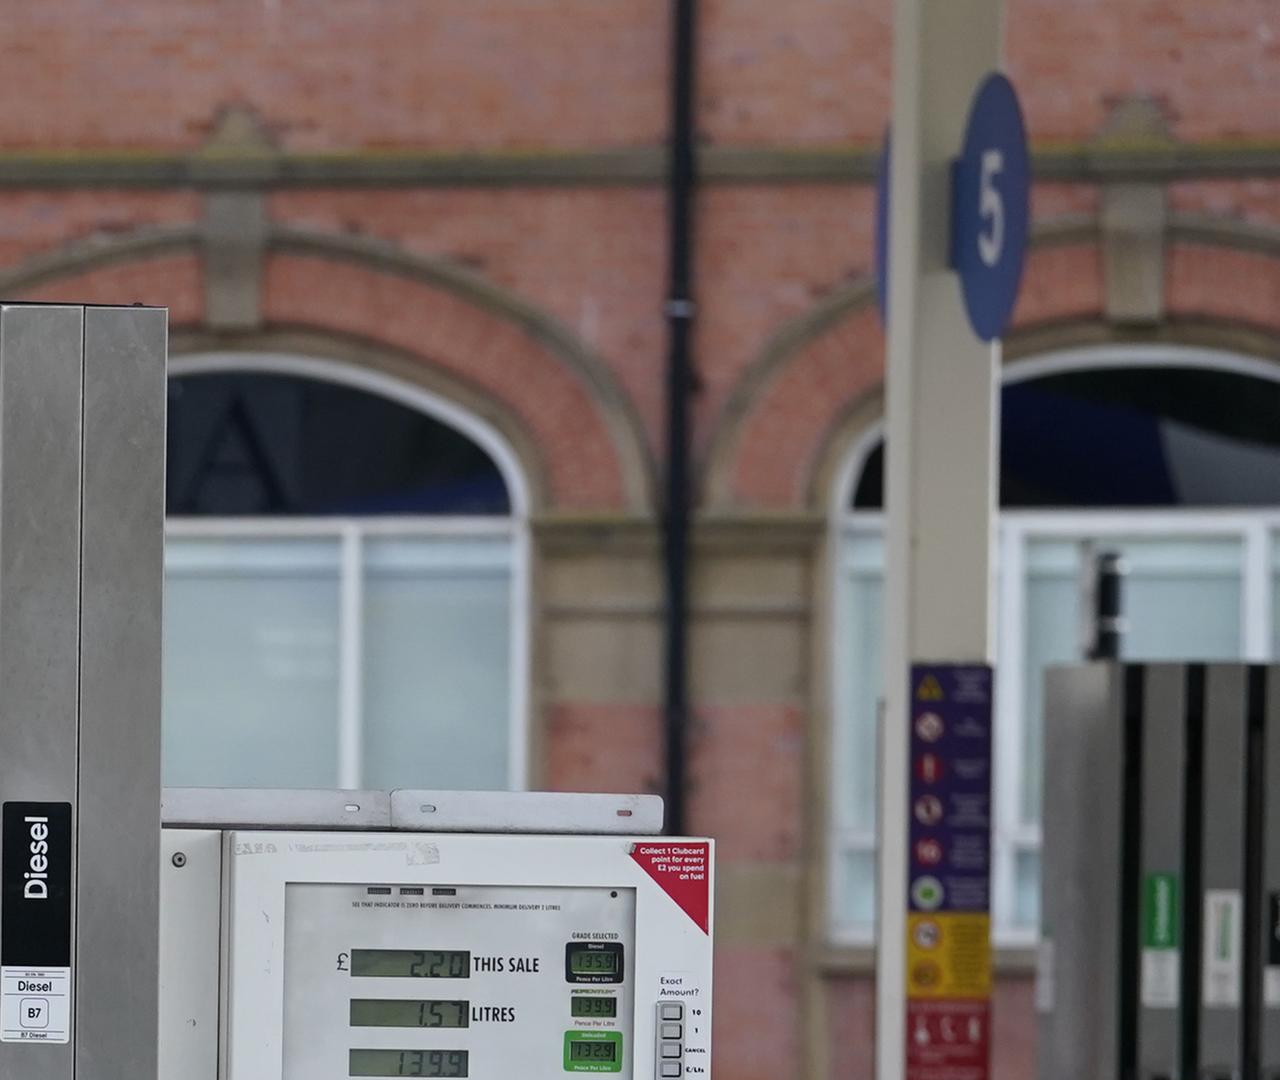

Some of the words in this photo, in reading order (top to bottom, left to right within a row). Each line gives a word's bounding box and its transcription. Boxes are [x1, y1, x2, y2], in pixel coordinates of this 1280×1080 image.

[977, 149, 1005, 267] 5
[24, 816, 48, 898] Diesel
[651, 856, 671, 864] point
[337, 953, 349, 971] £
[410, 952, 464, 977] 2.20
[473, 957, 504, 972] THIS
[509, 957, 539, 973] SALE
[577, 953, 612, 970] 135.9
[18, 980, 52, 992] Diesel
[660, 977, 682, 985] Exact
[660, 988, 699, 996] Amount?
[28, 1007, 41, 1018] B7
[418, 1002, 463, 1027] 1.57
[472, 1007, 515, 1022] LITRES
[577, 998, 612, 1016] 139.9
[576, 1044, 611, 1061] 132.9
[399, 1052, 462, 1076] 139.9
